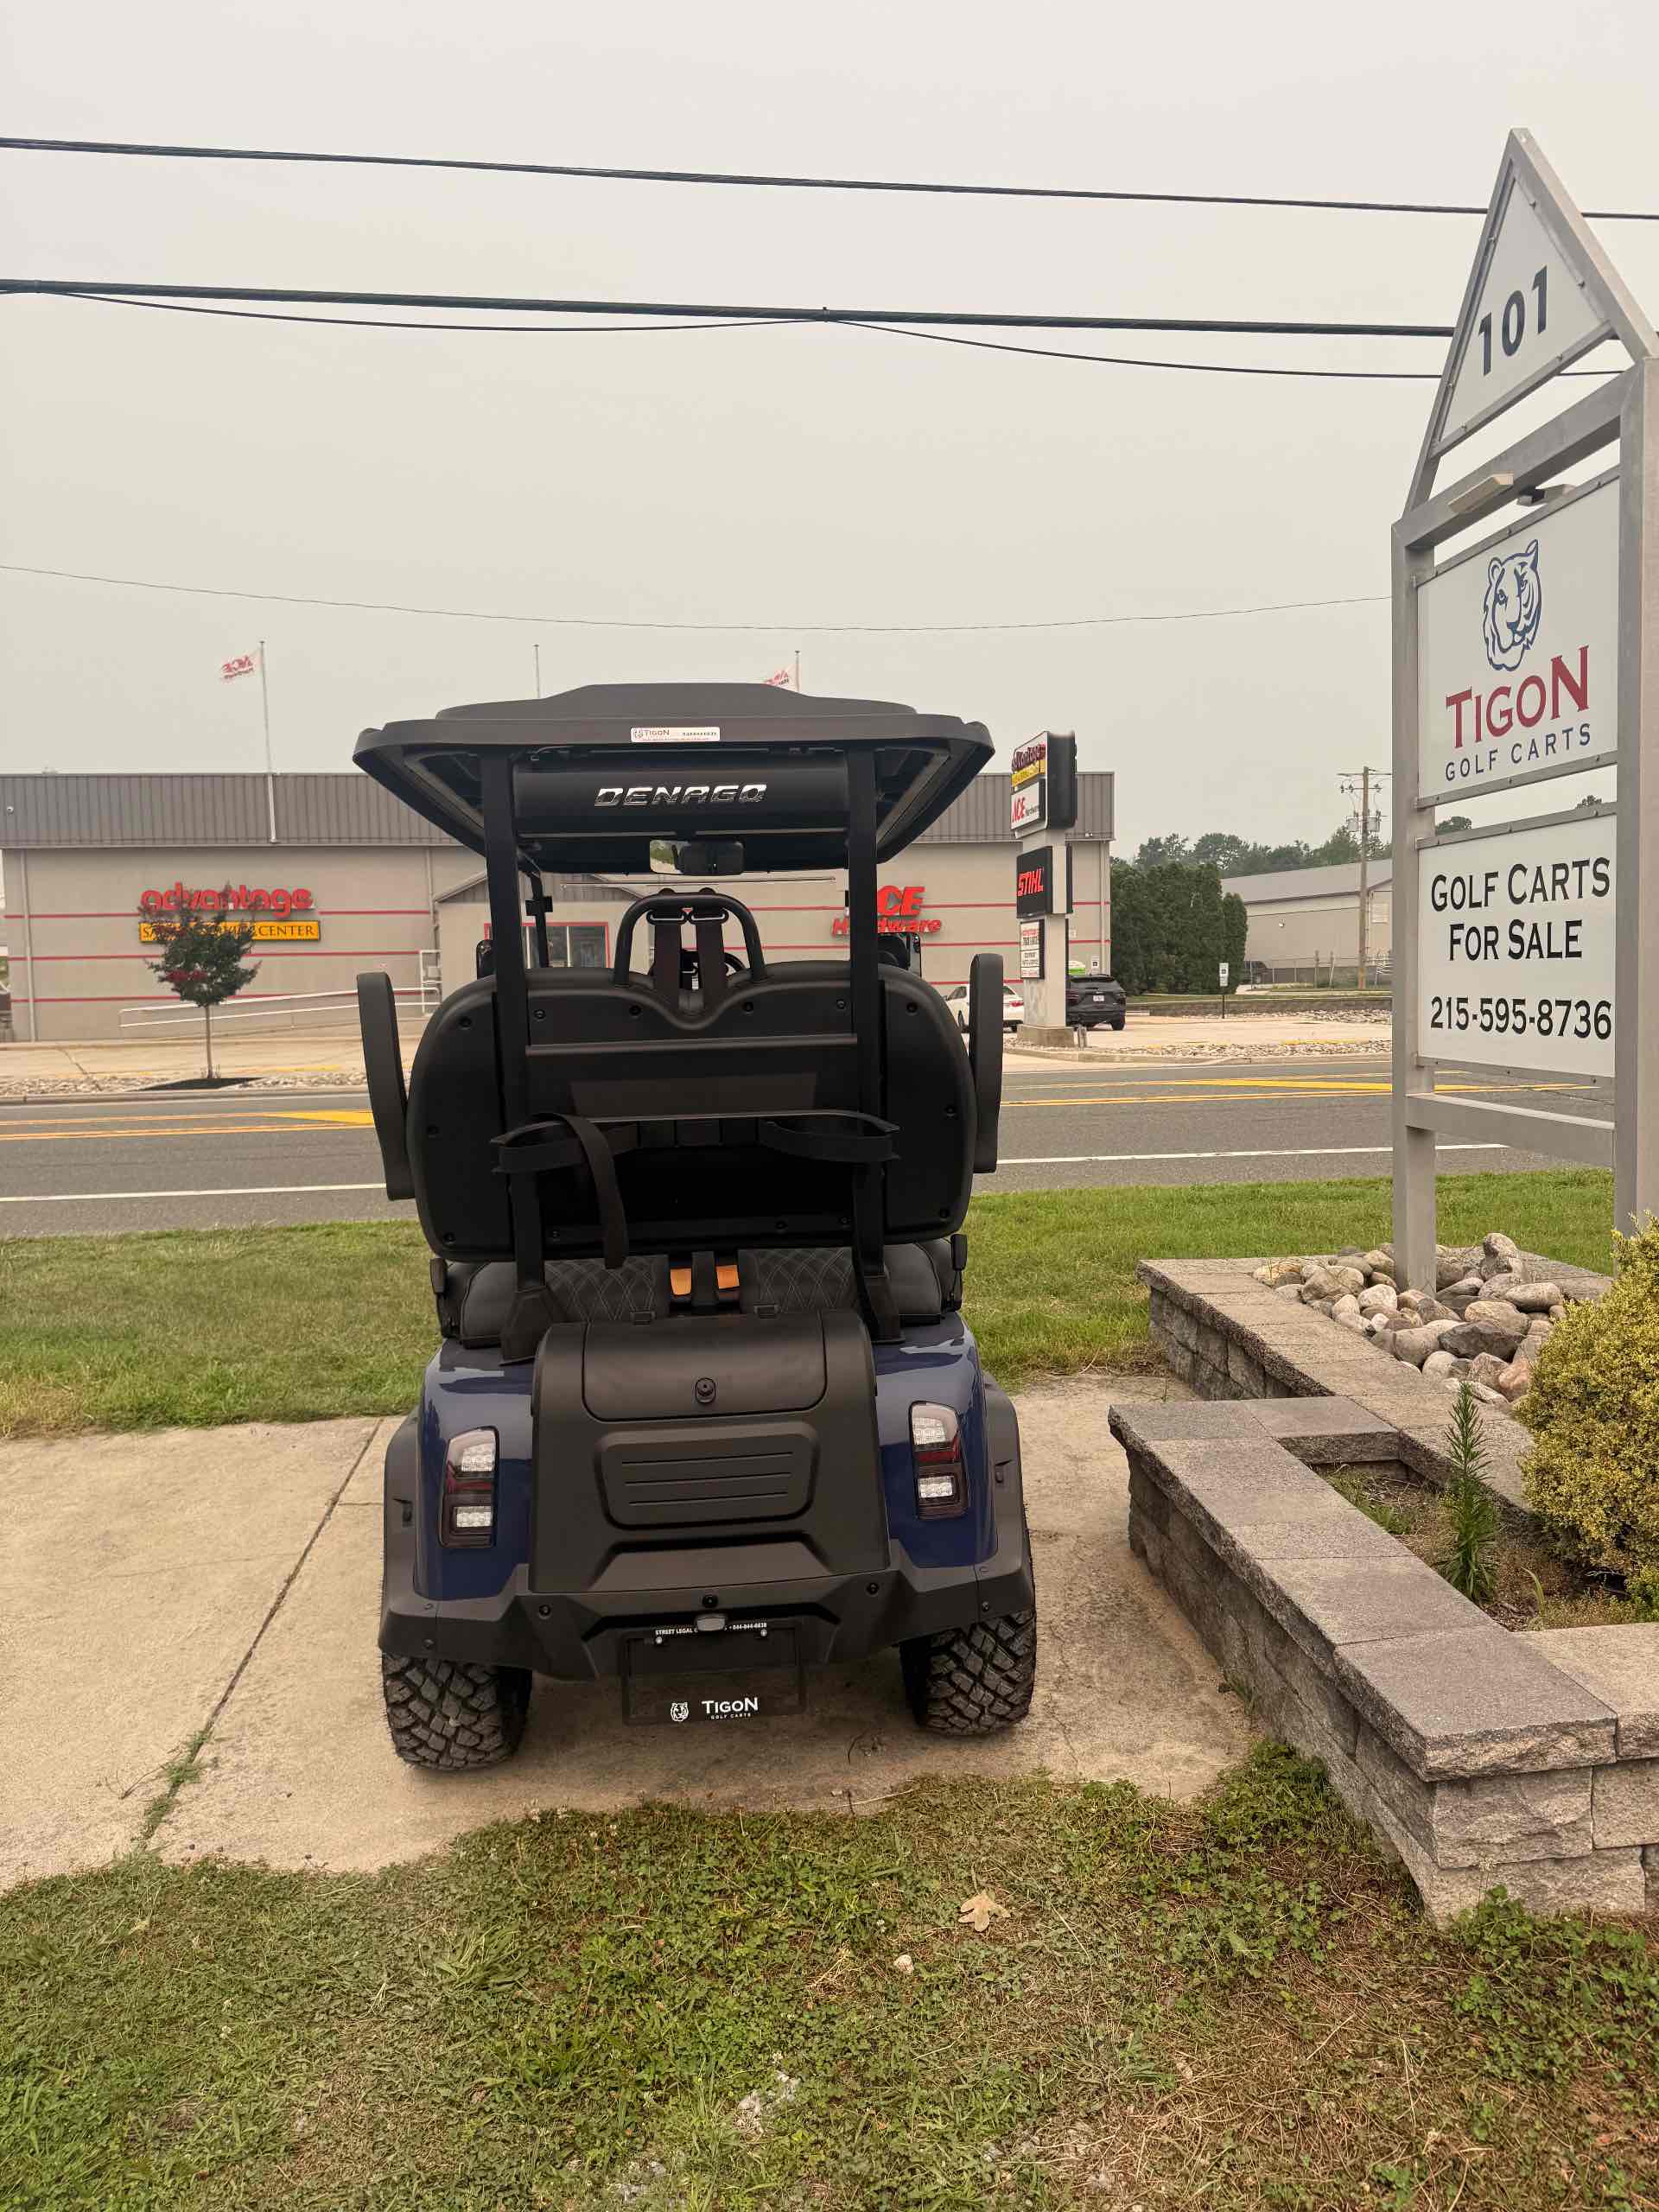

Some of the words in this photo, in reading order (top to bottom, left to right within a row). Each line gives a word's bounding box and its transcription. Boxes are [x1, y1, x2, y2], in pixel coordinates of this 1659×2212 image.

[1478, 265, 1547, 376] 101
[1446, 645, 1589, 748] TIGON
[1446, 750, 1498, 781] GOLF
[1511, 723, 1591, 764] CARTS
[594, 785, 767, 807] DENAGO
[877, 885, 925, 917] CE
[1017, 868, 1044, 897] STIHL
[1431, 871, 1499, 912] GOLF
[1508, 857, 1611, 905] CARTS
[258, 925, 315, 937] CENTER
[1448, 923, 1499, 961] FOR
[1508, 918, 1582, 960] SALE
[1430, 995, 1612, 1039] 215-595-8736
[701, 1697, 759, 1714] TIGON
